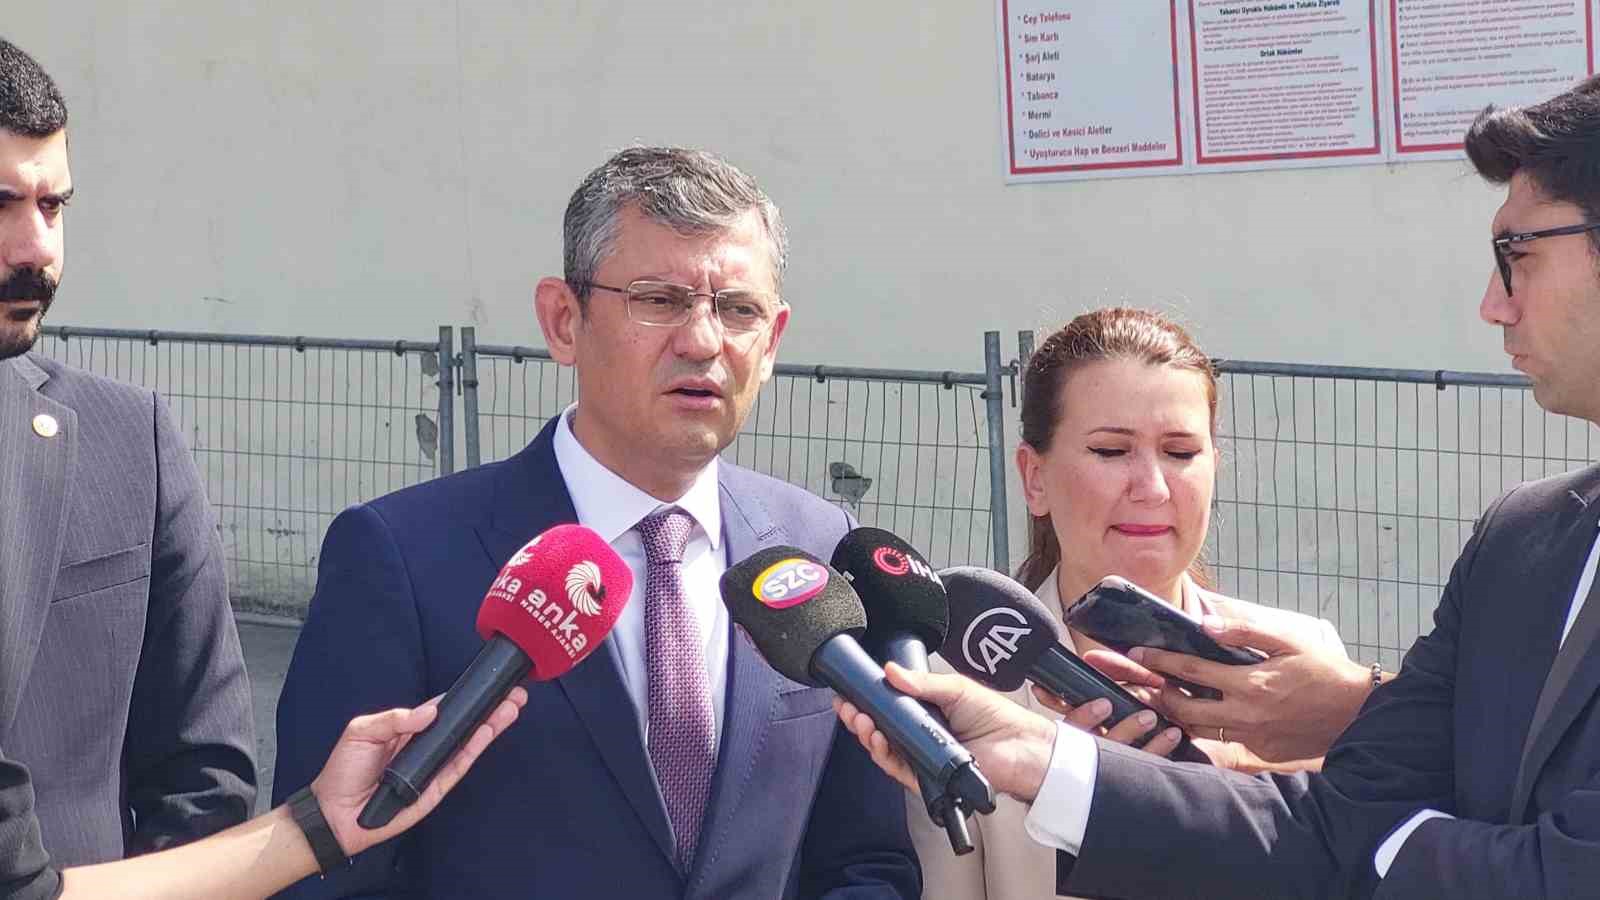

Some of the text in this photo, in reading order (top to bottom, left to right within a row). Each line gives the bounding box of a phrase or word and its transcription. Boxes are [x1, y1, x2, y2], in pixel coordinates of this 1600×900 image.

[1023, 11, 1072, 26] Cep Telefonu
[1024, 32, 1039, 43] Sim
[1042, 50, 1060, 61] Aleti
[1026, 71, 1056, 83] Batarya
[1027, 91, 1059, 101] Tabanca
[1028, 110, 1052, 120] Mermi
[1062, 127, 1086, 137] Kesici
[1087, 125, 1113, 136] Aletler
[1074, 145, 1090, 157] Hap
[1101, 143, 1131, 154] Benzeri
[1132, 141, 1167, 152] Maddeler
[762, 563, 820, 599] SZC
[527, 588, 588, 652] anka
[519, 599, 578, 659] HABER AJANSI
[977, 624, 1033, 676] AA
